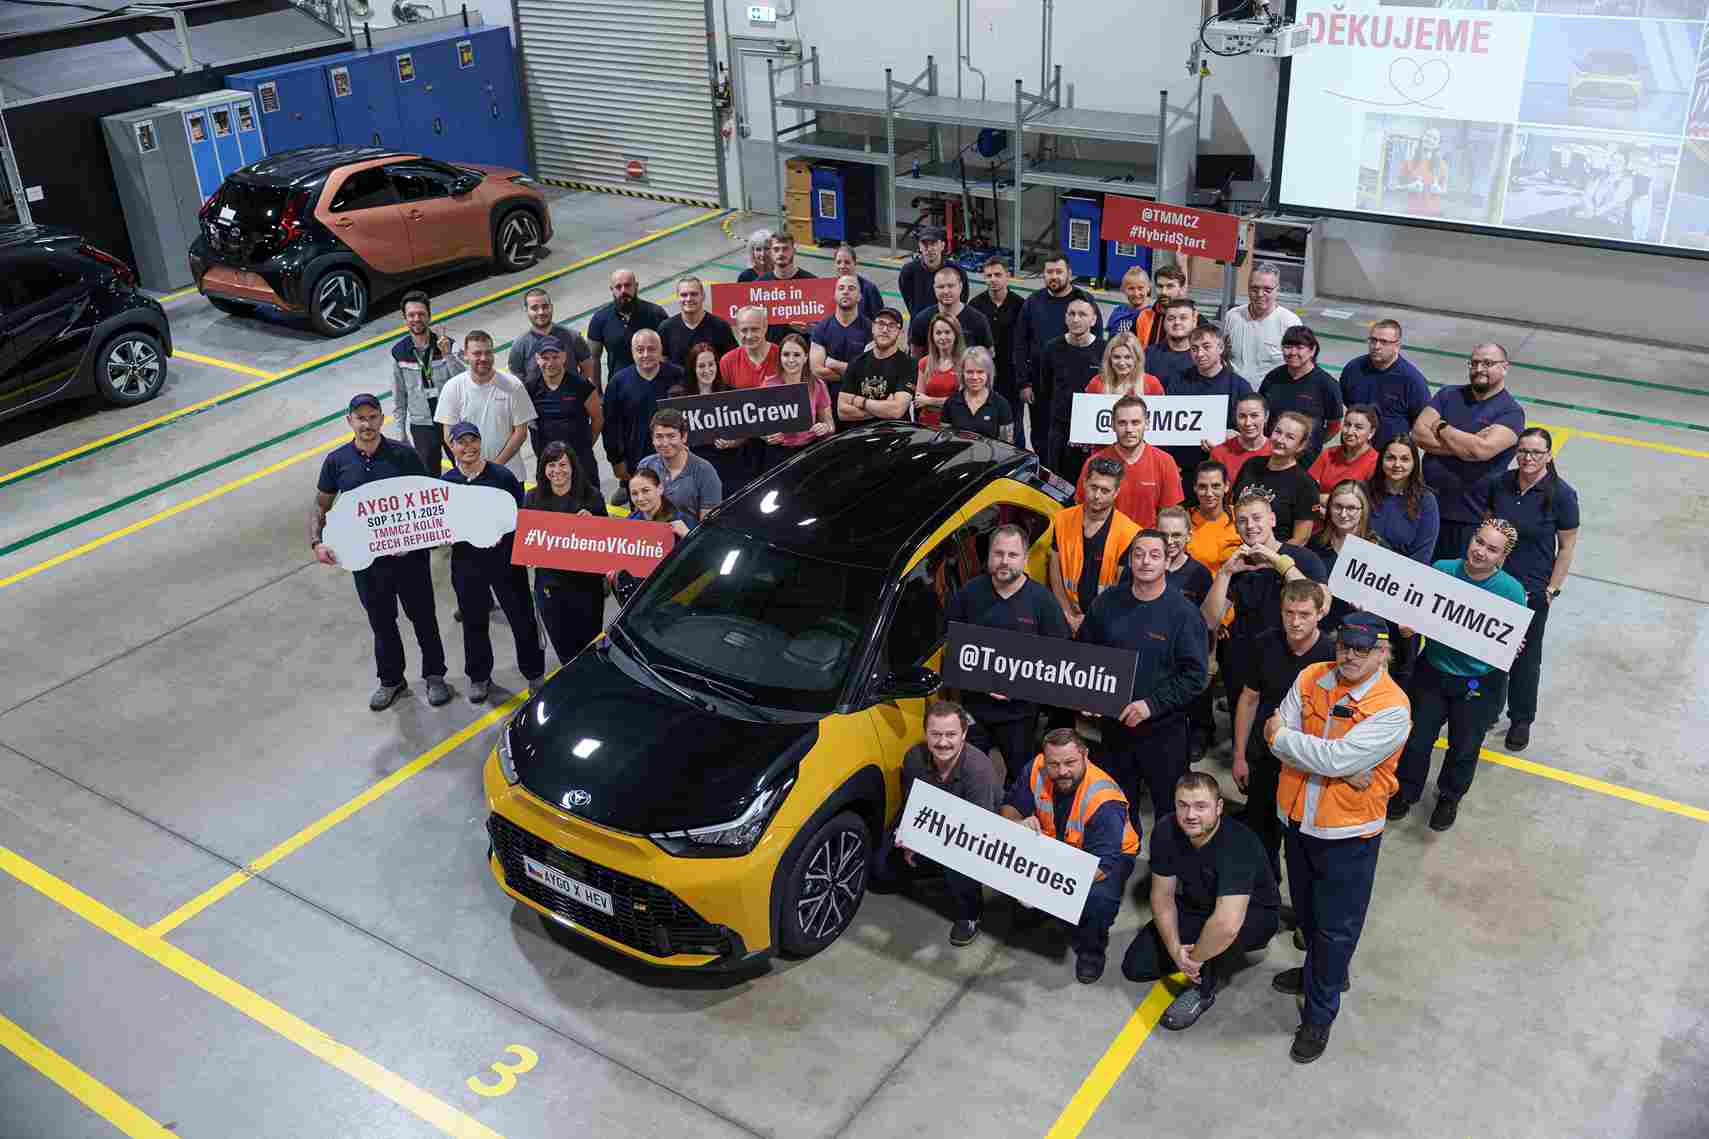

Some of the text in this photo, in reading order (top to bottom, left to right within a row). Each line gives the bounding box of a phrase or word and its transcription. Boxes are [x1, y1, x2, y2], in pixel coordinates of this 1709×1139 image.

[1305, 4, 1492, 54] DĚKUJEME
[1142, 207, 1200, 229] @TMMCZ
[1129, 225, 1207, 249] #HybridStart
[750, 286, 802, 302] Made in
[772, 301, 825, 319] republic
[682, 402, 800, 432] KolínCrew
[1096, 409, 1203, 432] @MCZ
[357, 486, 449, 517] AYGO X HEV
[367, 505, 445, 528] SOP 12.11.2025
[373, 517, 443, 539] TMMCZ KOLÍN
[369, 528, 452, 553] CZECH REPUBLIC
[524, 528, 664, 558] #VyrobenoVKolíně
[1345, 558, 1515, 646] Made in TMMCZ
[959, 643, 1117, 694] @ToyotaKolín
[912, 806, 1077, 896] #HybridHeroes
[543, 869, 570, 892] AYGO
[574, 882, 582, 896] X
[584, 887, 608, 909] HEV
